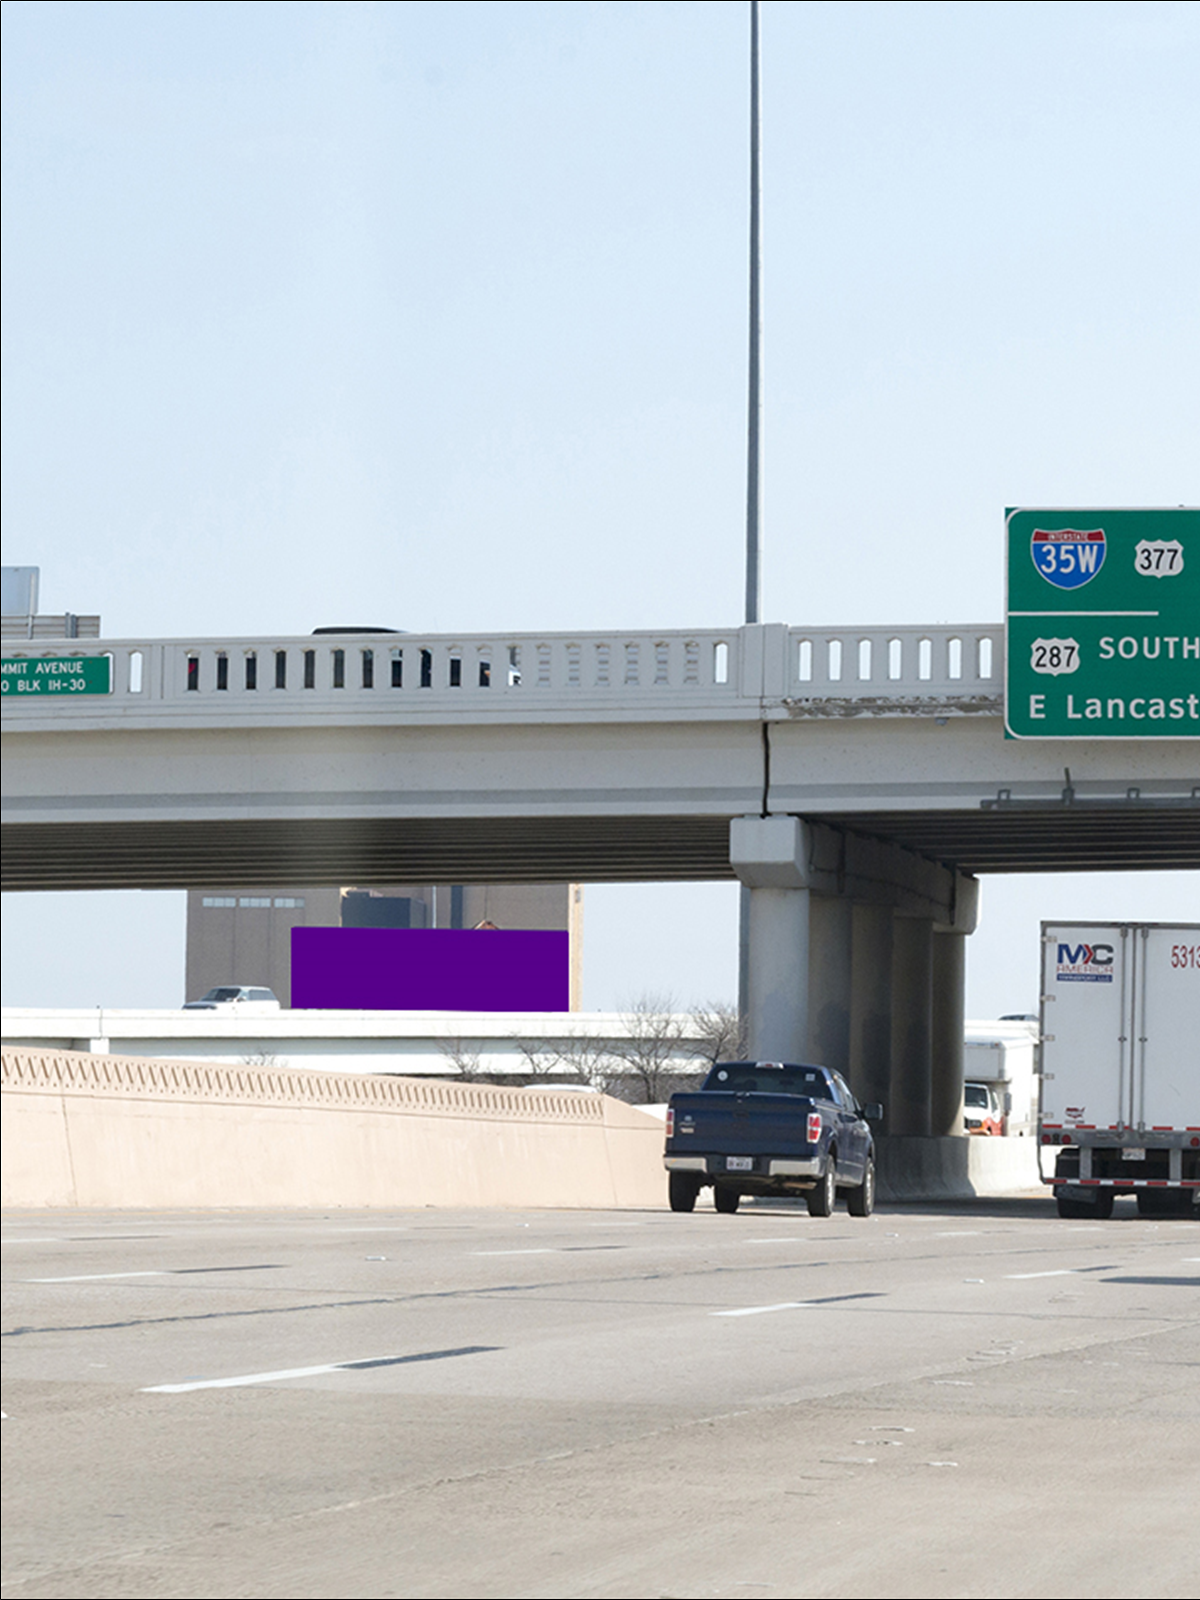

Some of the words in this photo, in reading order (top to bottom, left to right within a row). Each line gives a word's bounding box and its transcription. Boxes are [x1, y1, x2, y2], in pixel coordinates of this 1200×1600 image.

[1041, 545, 1098, 573] 35W
[1140, 548, 1178, 570] 377
[1035, 646, 1076, 668] 287
[1099, 637, 1200, 659] SOUTH
[35, 661, 84, 674] AVENUE
[17, 679, 41, 692] BLK
[48, 678, 86, 691] IH-30
[1029, 695, 1046, 719] E
[1056, 964, 1114, 974] AMERICA
